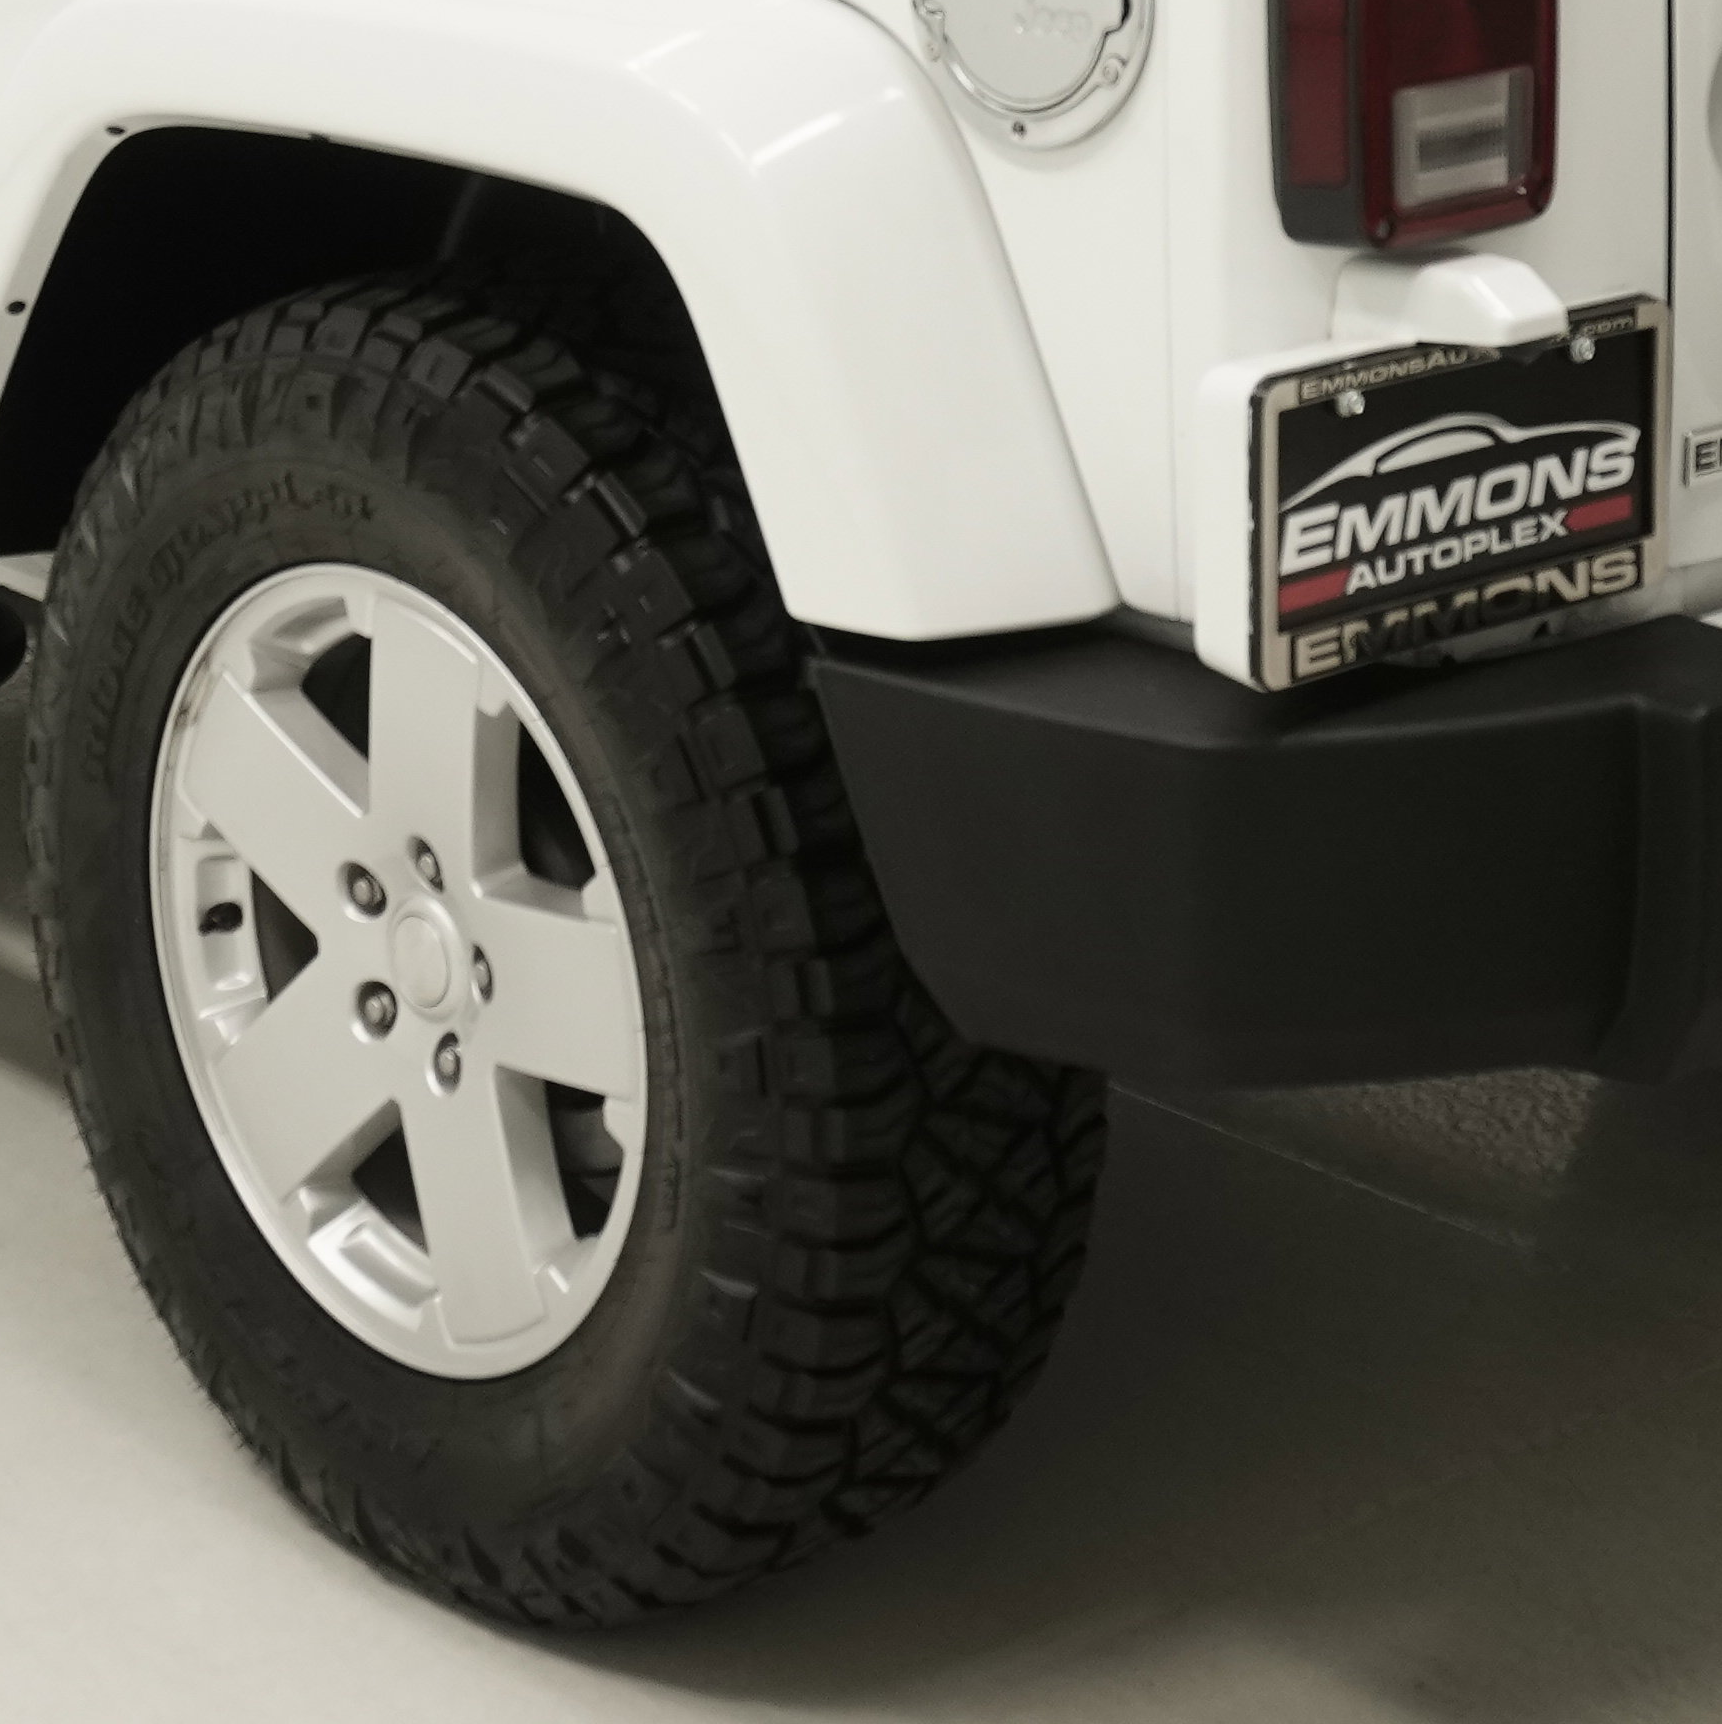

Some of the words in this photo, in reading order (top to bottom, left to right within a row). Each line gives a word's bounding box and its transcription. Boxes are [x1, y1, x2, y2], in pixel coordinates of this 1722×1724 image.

[1280, 436, 1638, 576] EMMONS
[1345, 508, 1571, 596] AUTOPLEX
[1293, 547, 1640, 678] EMMONS
